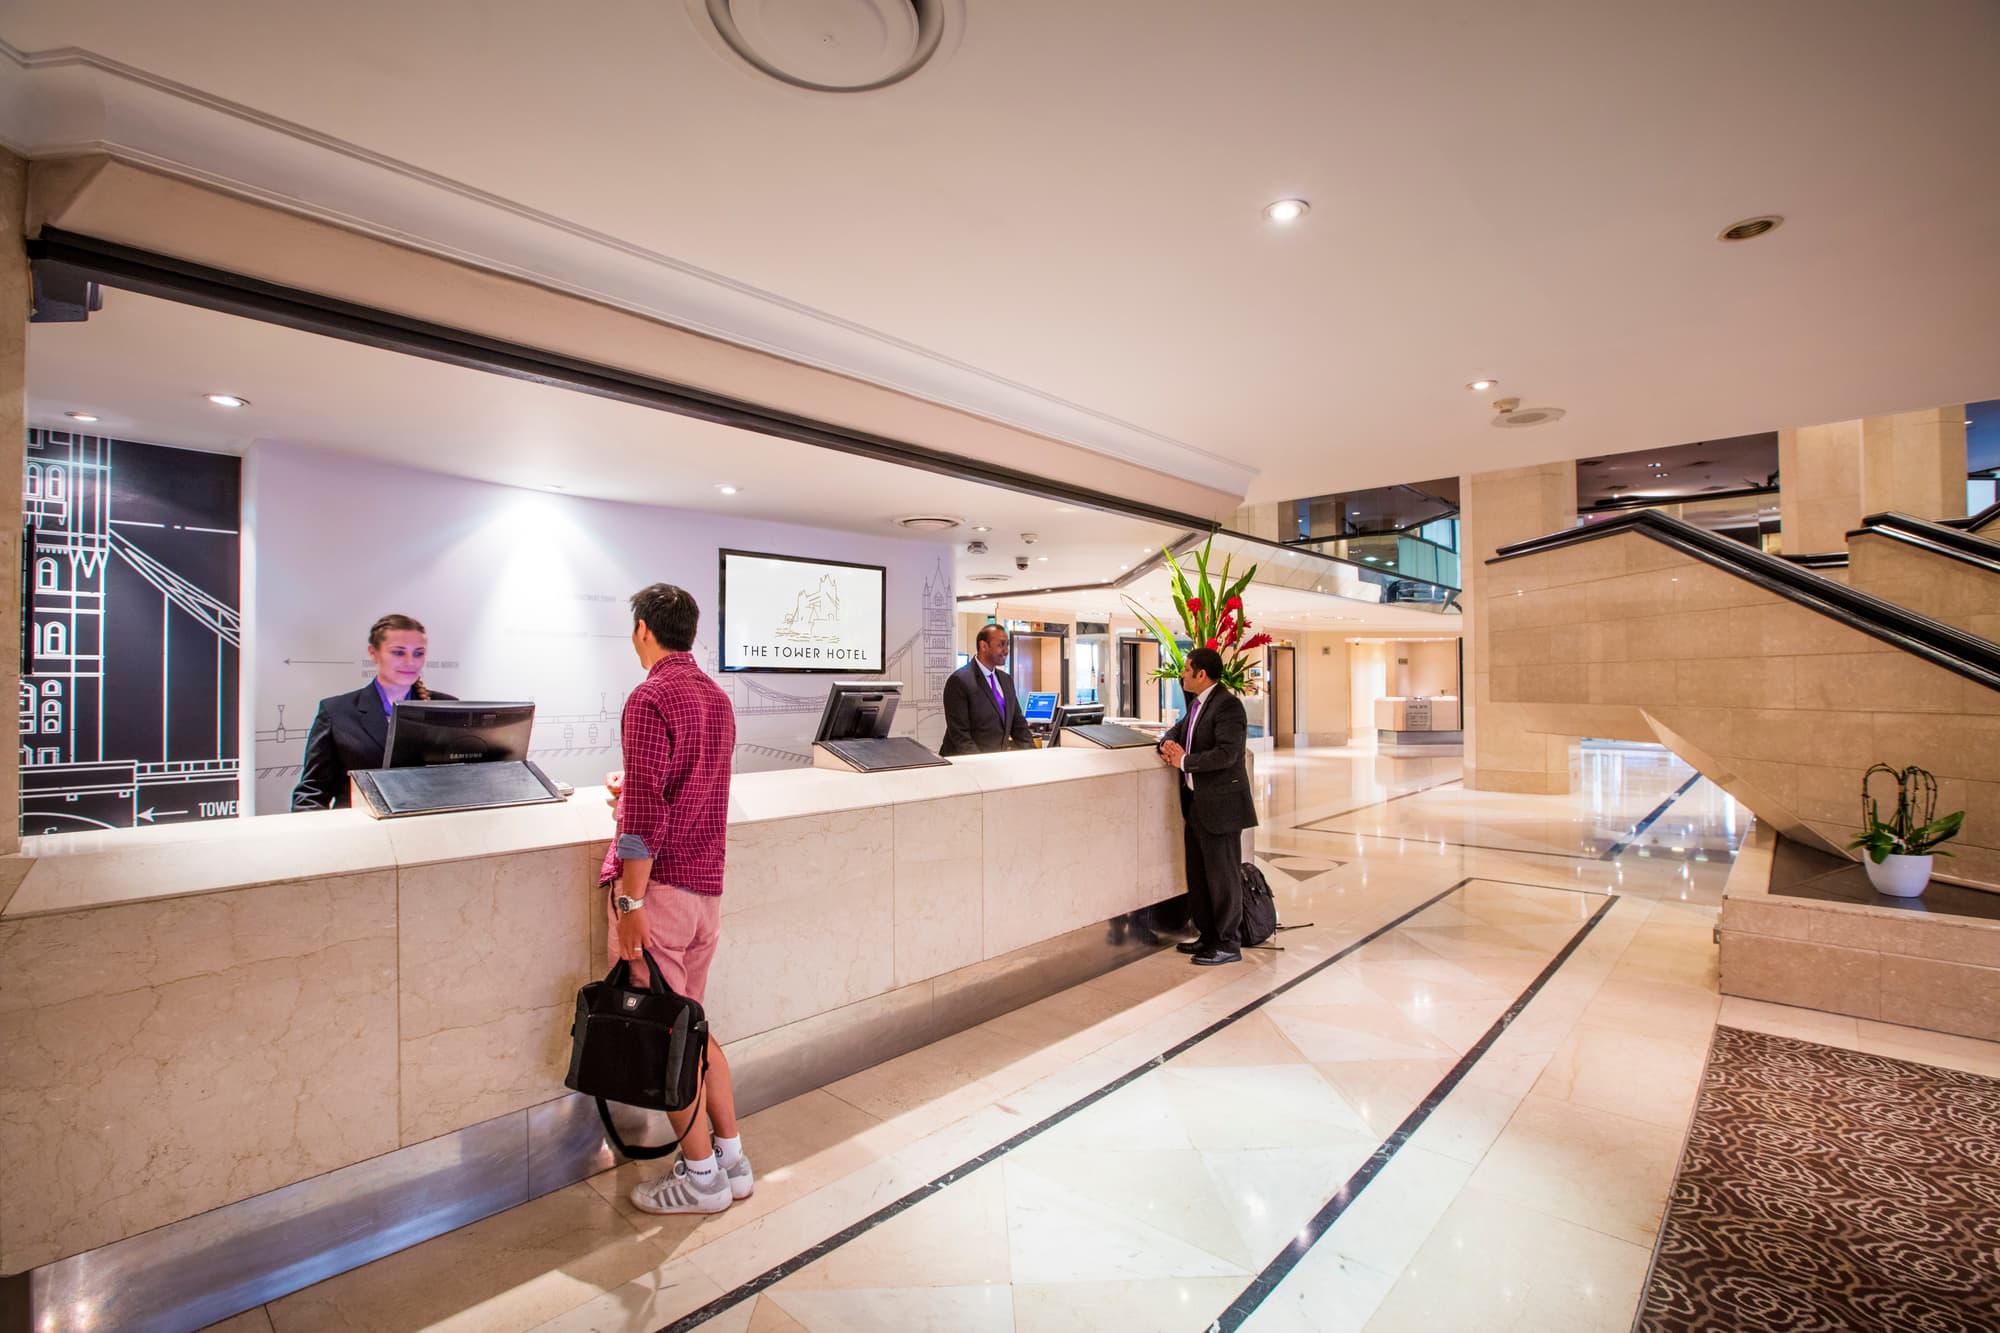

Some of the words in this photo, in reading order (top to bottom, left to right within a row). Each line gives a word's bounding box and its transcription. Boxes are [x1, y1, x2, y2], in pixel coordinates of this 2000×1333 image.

[743, 645, 767, 657] THE
[774, 646, 820, 659] TOWER
[827, 648, 867, 660] HOTEL
